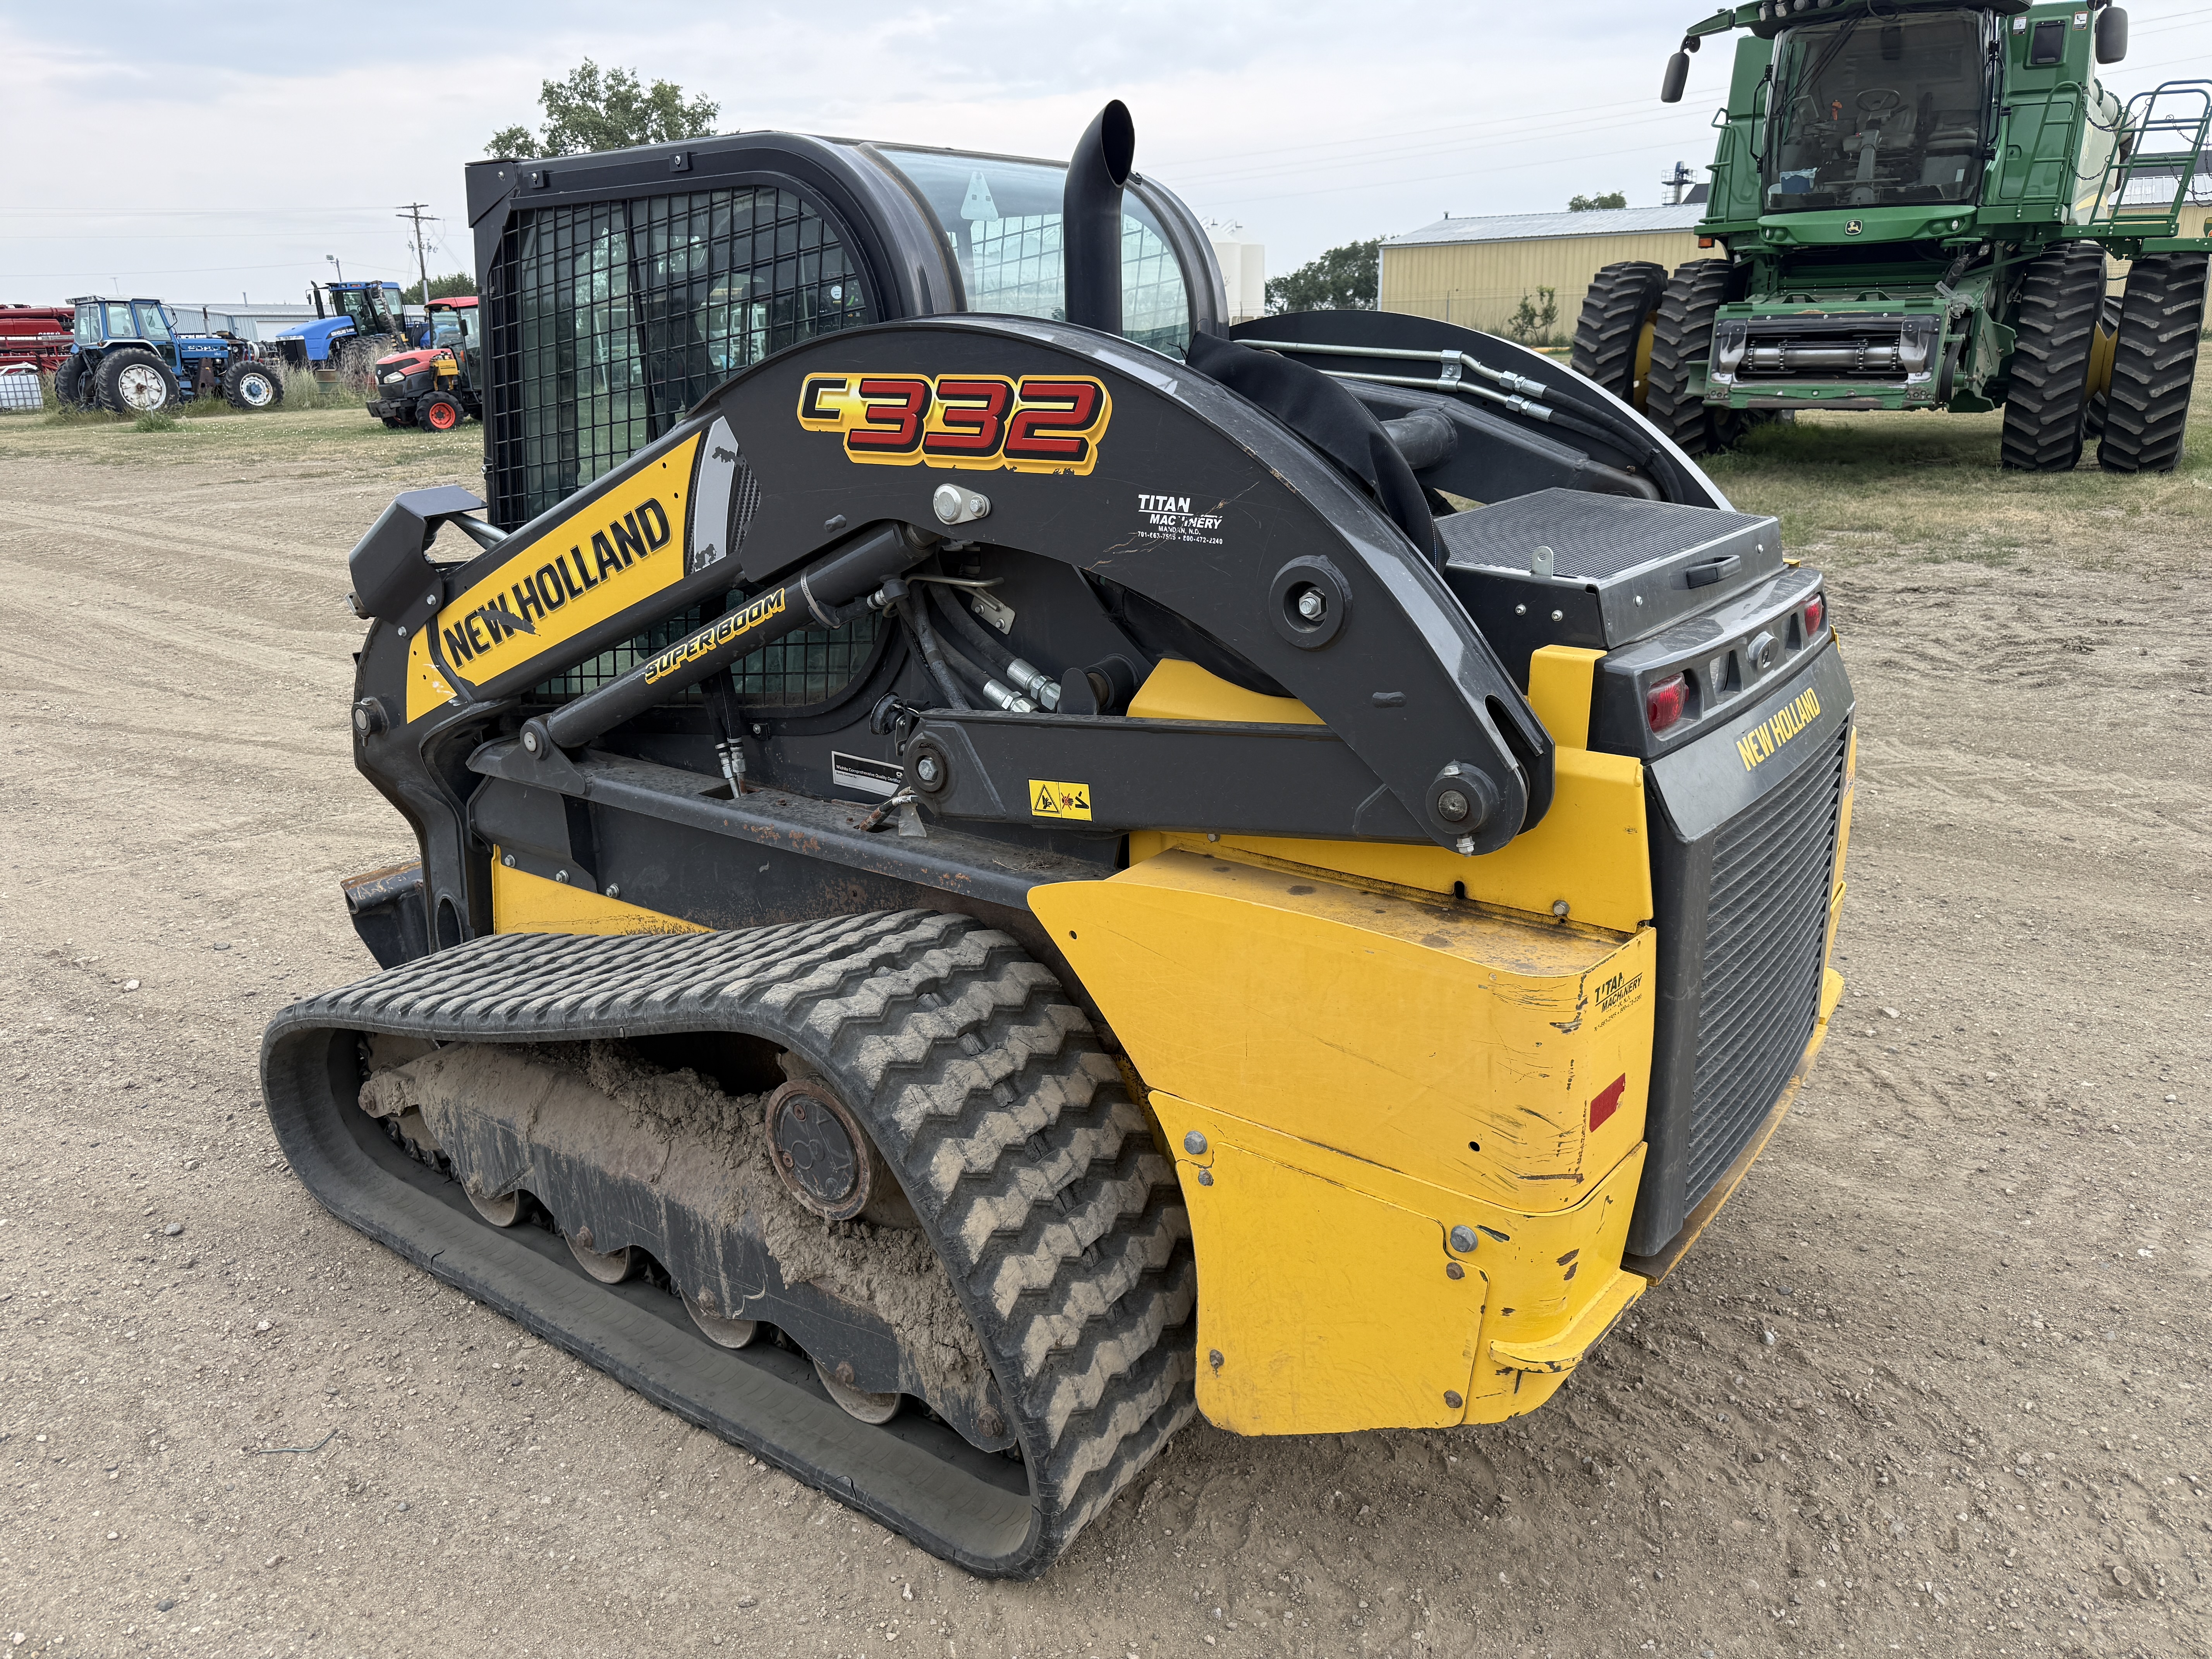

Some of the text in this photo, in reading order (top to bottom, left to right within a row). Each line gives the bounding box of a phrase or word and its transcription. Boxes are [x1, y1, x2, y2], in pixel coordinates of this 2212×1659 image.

[799, 376, 1108, 465] C332
[1138, 494, 1191, 513] TITAN
[1183, 535, 1223, 544] 800-472-2240
[443, 498, 671, 669] NEW HOLLAND
[645, 588, 785, 682] SUPER BOOM
[1736, 687, 1820, 771] NEW HOLLAND
[1595, 972, 1625, 1003] TITAN
[1601, 975, 1642, 1013] MACHINERY
